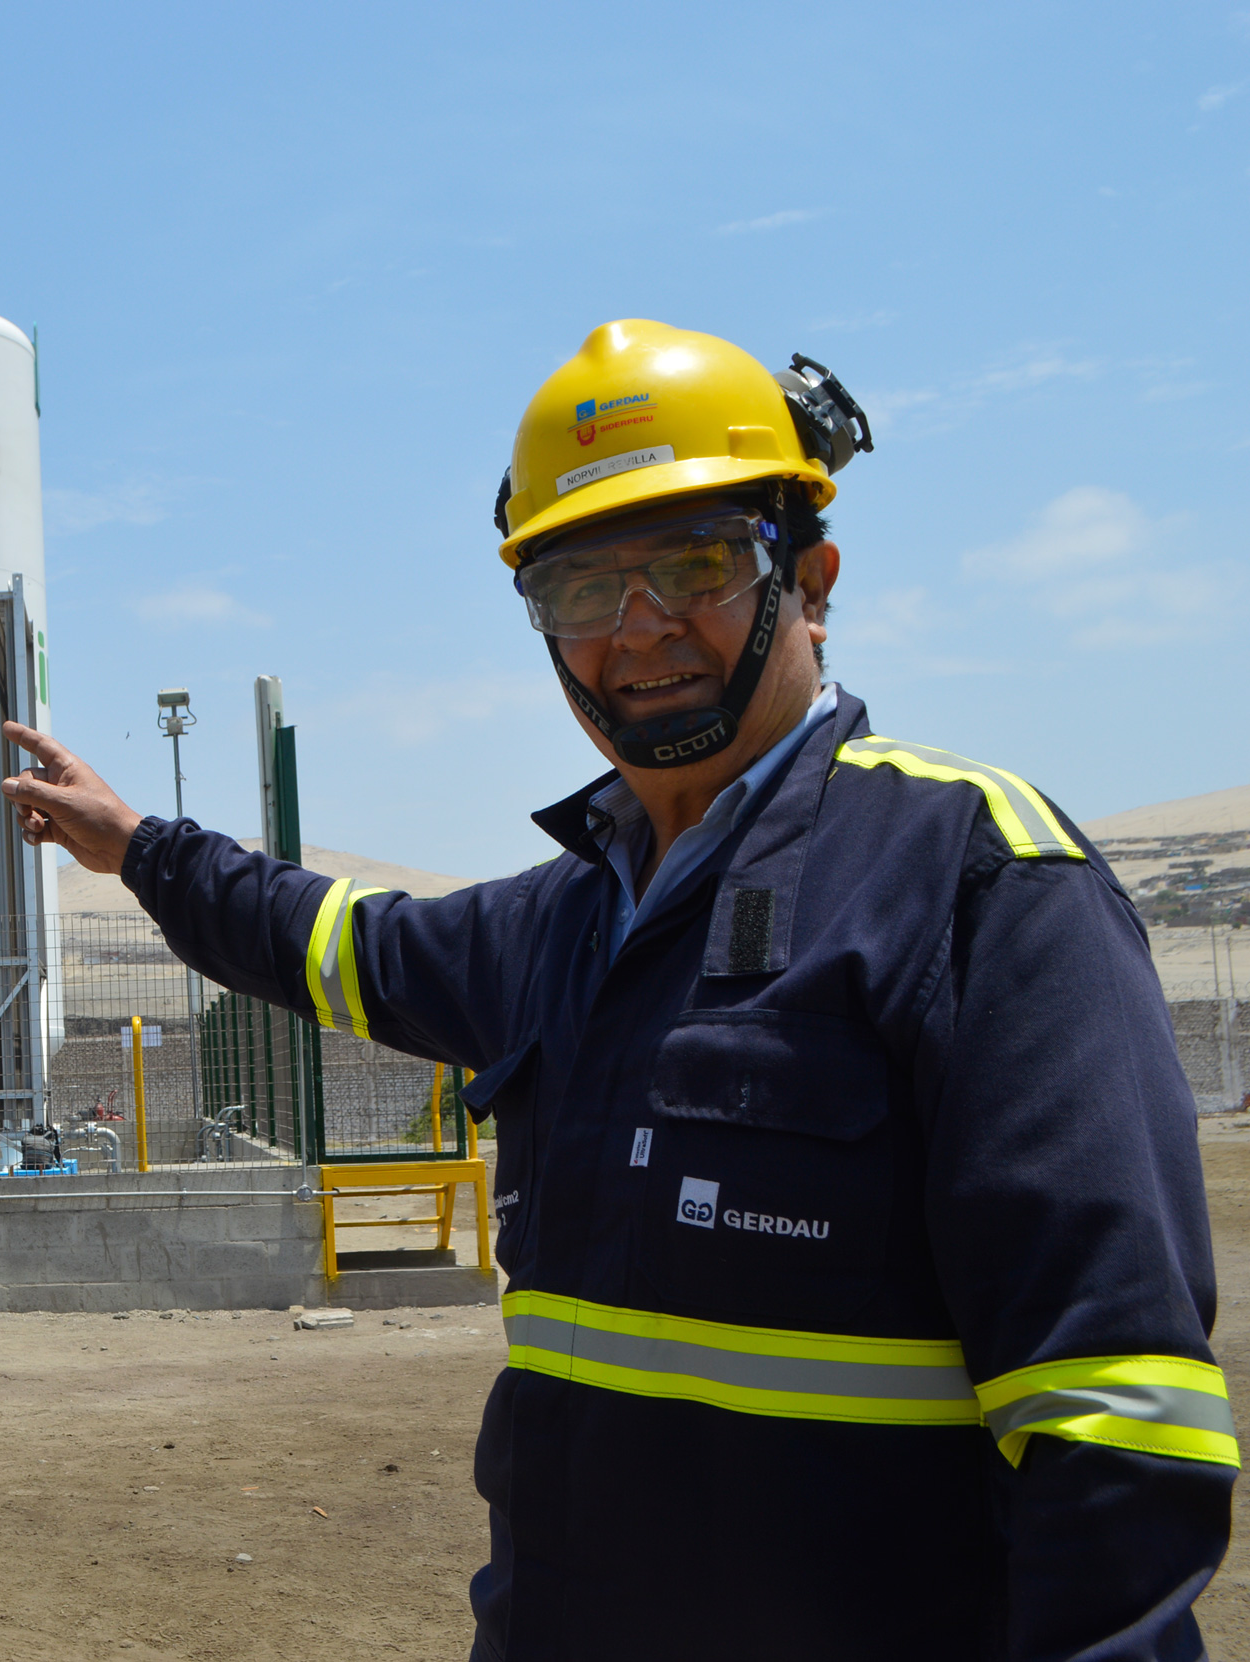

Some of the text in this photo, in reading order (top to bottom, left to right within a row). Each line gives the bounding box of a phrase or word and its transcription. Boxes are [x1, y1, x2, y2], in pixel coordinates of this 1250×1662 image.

[599, 393, 649, 412] GERDAU
[600, 415, 654, 433] SIDERPERU
[557, 662, 611, 736] CLUTE
[723, 1209, 830, 1240] GERDAU
